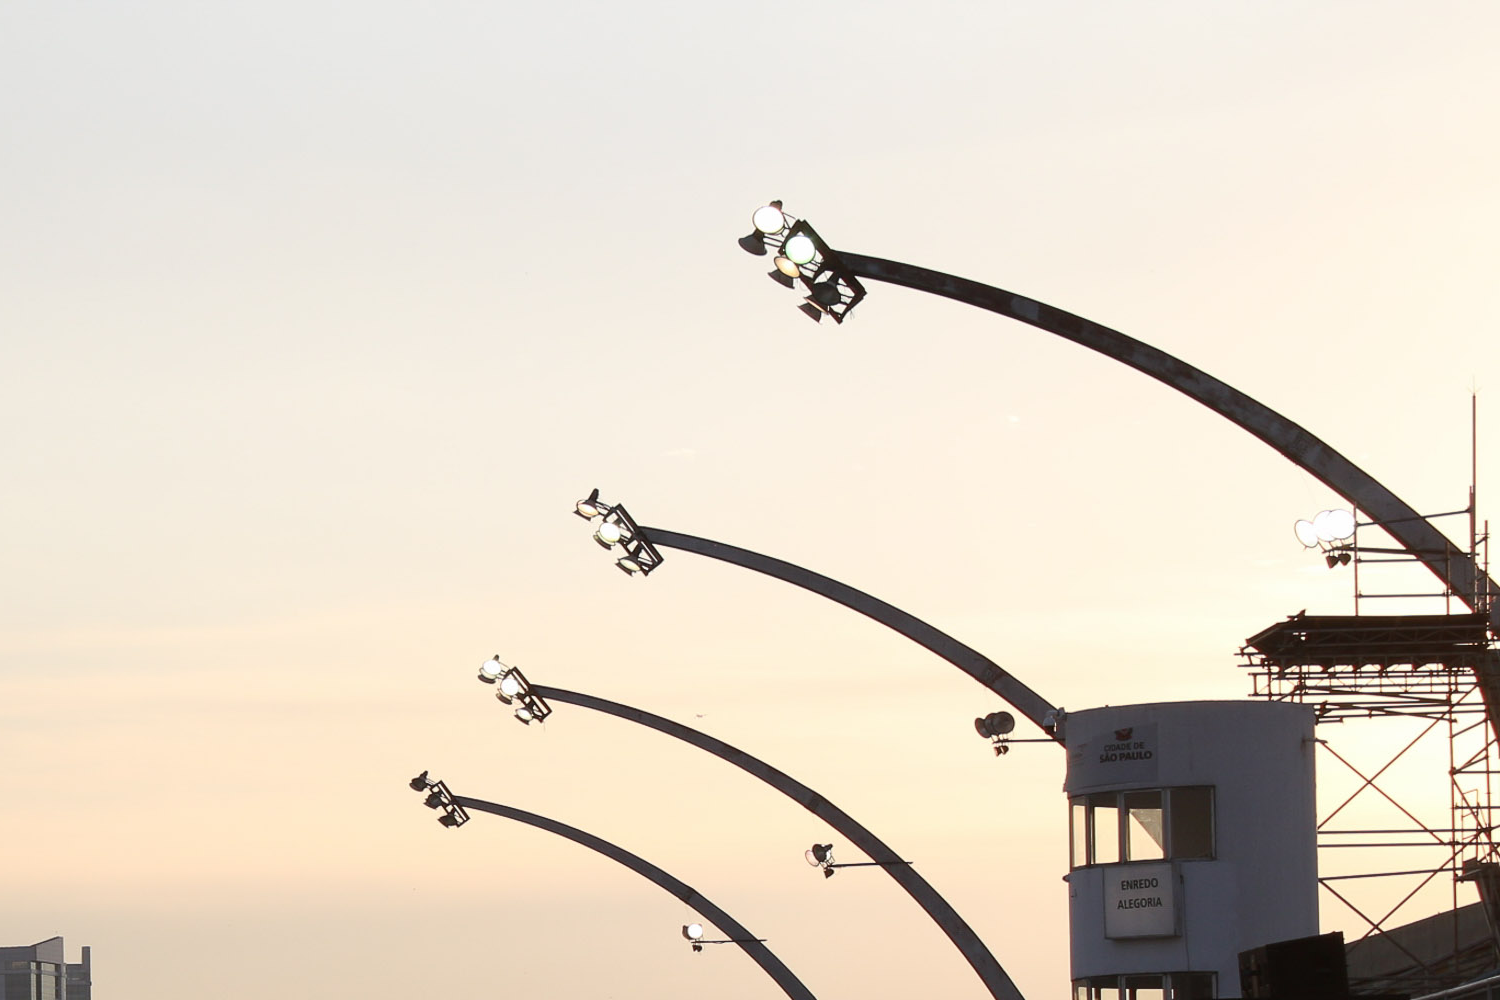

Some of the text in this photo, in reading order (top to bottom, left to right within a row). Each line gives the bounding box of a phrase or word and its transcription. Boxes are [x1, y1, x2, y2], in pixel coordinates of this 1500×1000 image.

[1103, 741, 1145, 752] CIDADE DE
[1099, 750, 1153, 763] SÃO PAULO
[1120, 877, 1159, 891] ENREDO
[1116, 897, 1163, 910] ALEGORIA
